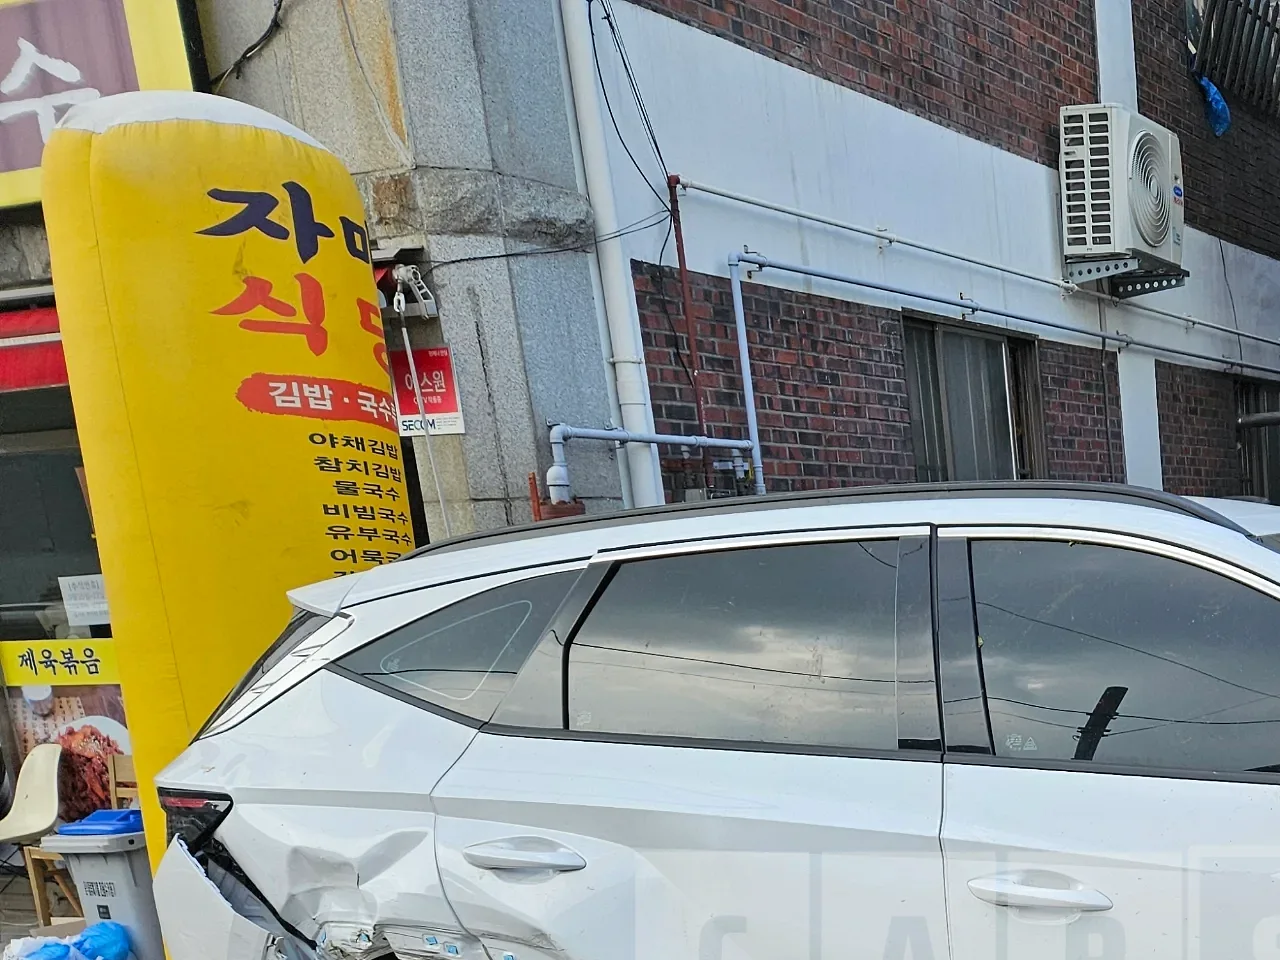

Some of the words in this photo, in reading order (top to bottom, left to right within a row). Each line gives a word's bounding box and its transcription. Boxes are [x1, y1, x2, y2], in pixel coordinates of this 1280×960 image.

[268, 381, 333, 411] 김밥
[308, 433, 398, 460] 야채김밥
[314, 456, 402, 483] 참치김밥
[333, 480, 400, 501] 물국수
[323, 504, 409, 526] 비빔국수
[325, 525, 412, 546] 유부국수
[330, 549, 401, 565] 어묵국
[18, 648, 101, 676] 제육볶음
